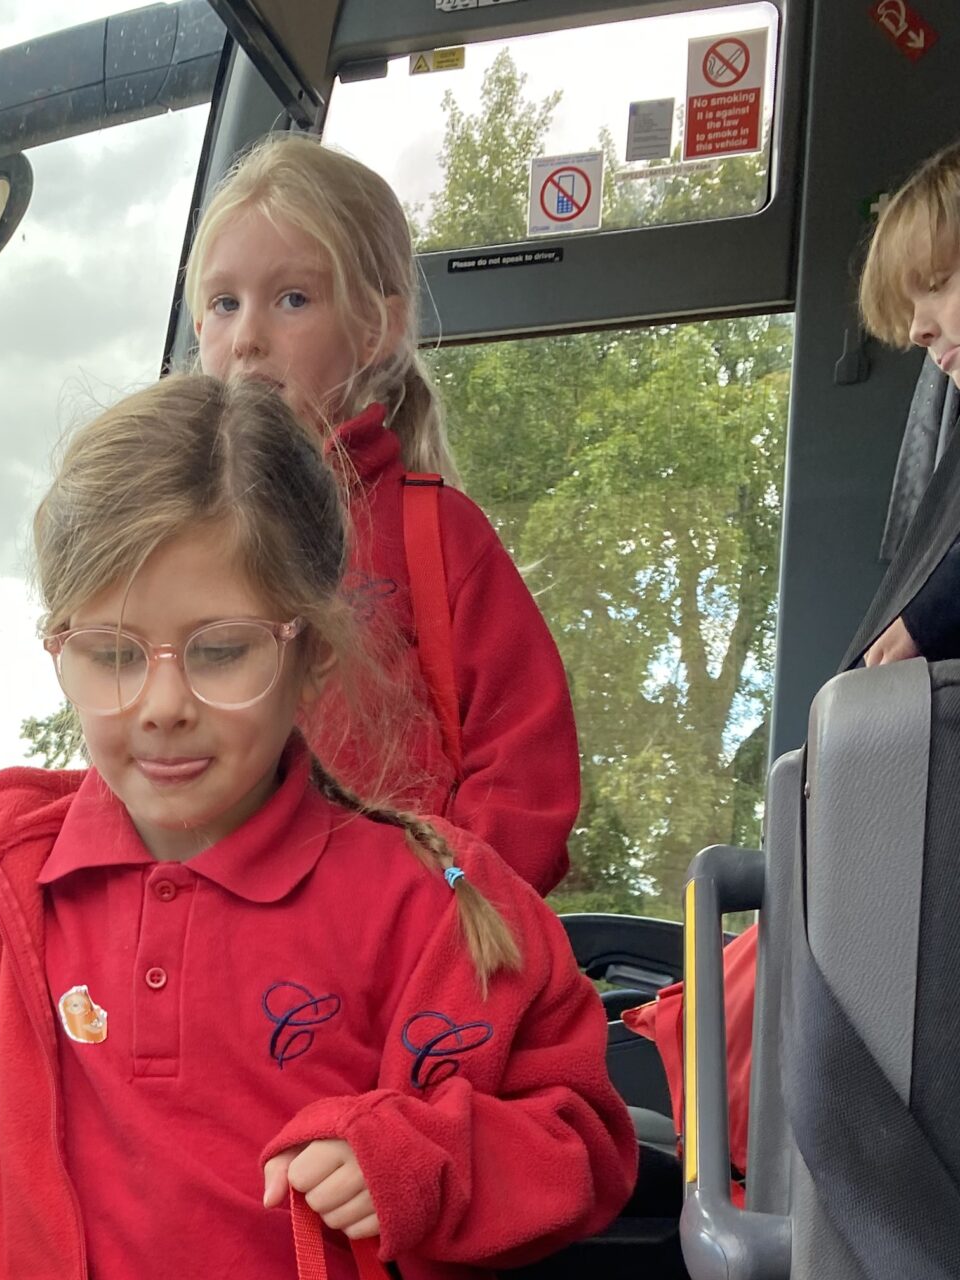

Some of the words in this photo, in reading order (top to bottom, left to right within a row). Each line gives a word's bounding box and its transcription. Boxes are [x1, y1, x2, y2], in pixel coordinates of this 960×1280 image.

[693, 98, 708, 108] No
[710, 92, 755, 106] smoking
[697, 111, 703, 120] It
[705, 110, 713, 119] is
[715, 105, 749, 119] against
[706, 120, 721, 130] the
[723, 118, 739, 127] law
[696, 132, 705, 141] to
[707, 129, 738, 140] smoke
[740, 127, 749, 135] in
[696, 142, 713, 152] this
[715, 137, 748, 149] vehicle
[452, 260, 476, 269] Please
[488, 257, 500, 265] not
[502, 255, 523, 265] speak
[534, 252, 556, 261] driver
